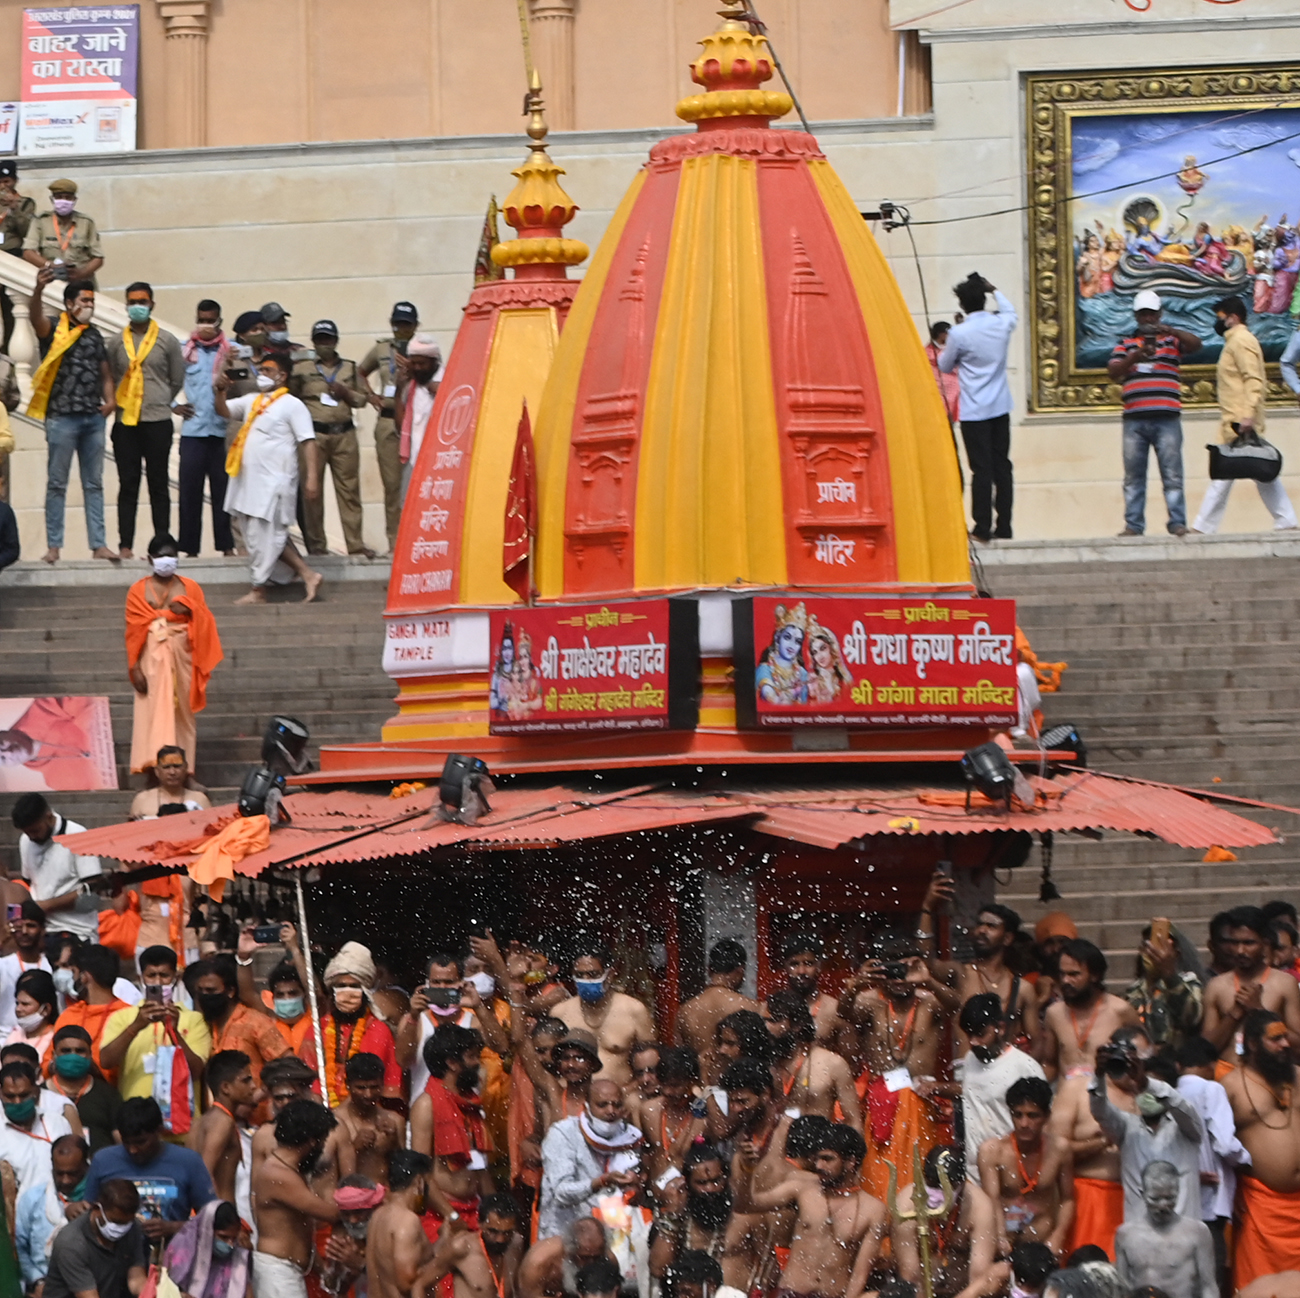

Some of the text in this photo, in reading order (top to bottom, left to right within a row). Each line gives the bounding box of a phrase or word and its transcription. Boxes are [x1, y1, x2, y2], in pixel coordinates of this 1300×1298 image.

[28, 27, 128, 53] बाहर जाने
[31, 58, 123, 78] का रास्ता
[433, 445, 464, 470] प्राचीन
[419, 475, 433, 500] श्री
[816, 477, 856, 504] प्राचीन
[814, 533, 856, 567] मंदिर
[585, 606, 619, 631] प्राचीन
[903, 601, 950, 625] प्राचीन
[422, 621, 450, 638] MATA
[540, 635, 559, 680] श्री
[617, 632, 667, 680] महादेव
[843, 620, 1014, 679] श्री राधा कृष्ण मन्दिर
[544, 687, 558, 712] श्री
[633, 682, 665, 708] मन्दिर
[850, 679, 1015, 706] श्री गंगा माता मन्दिर
